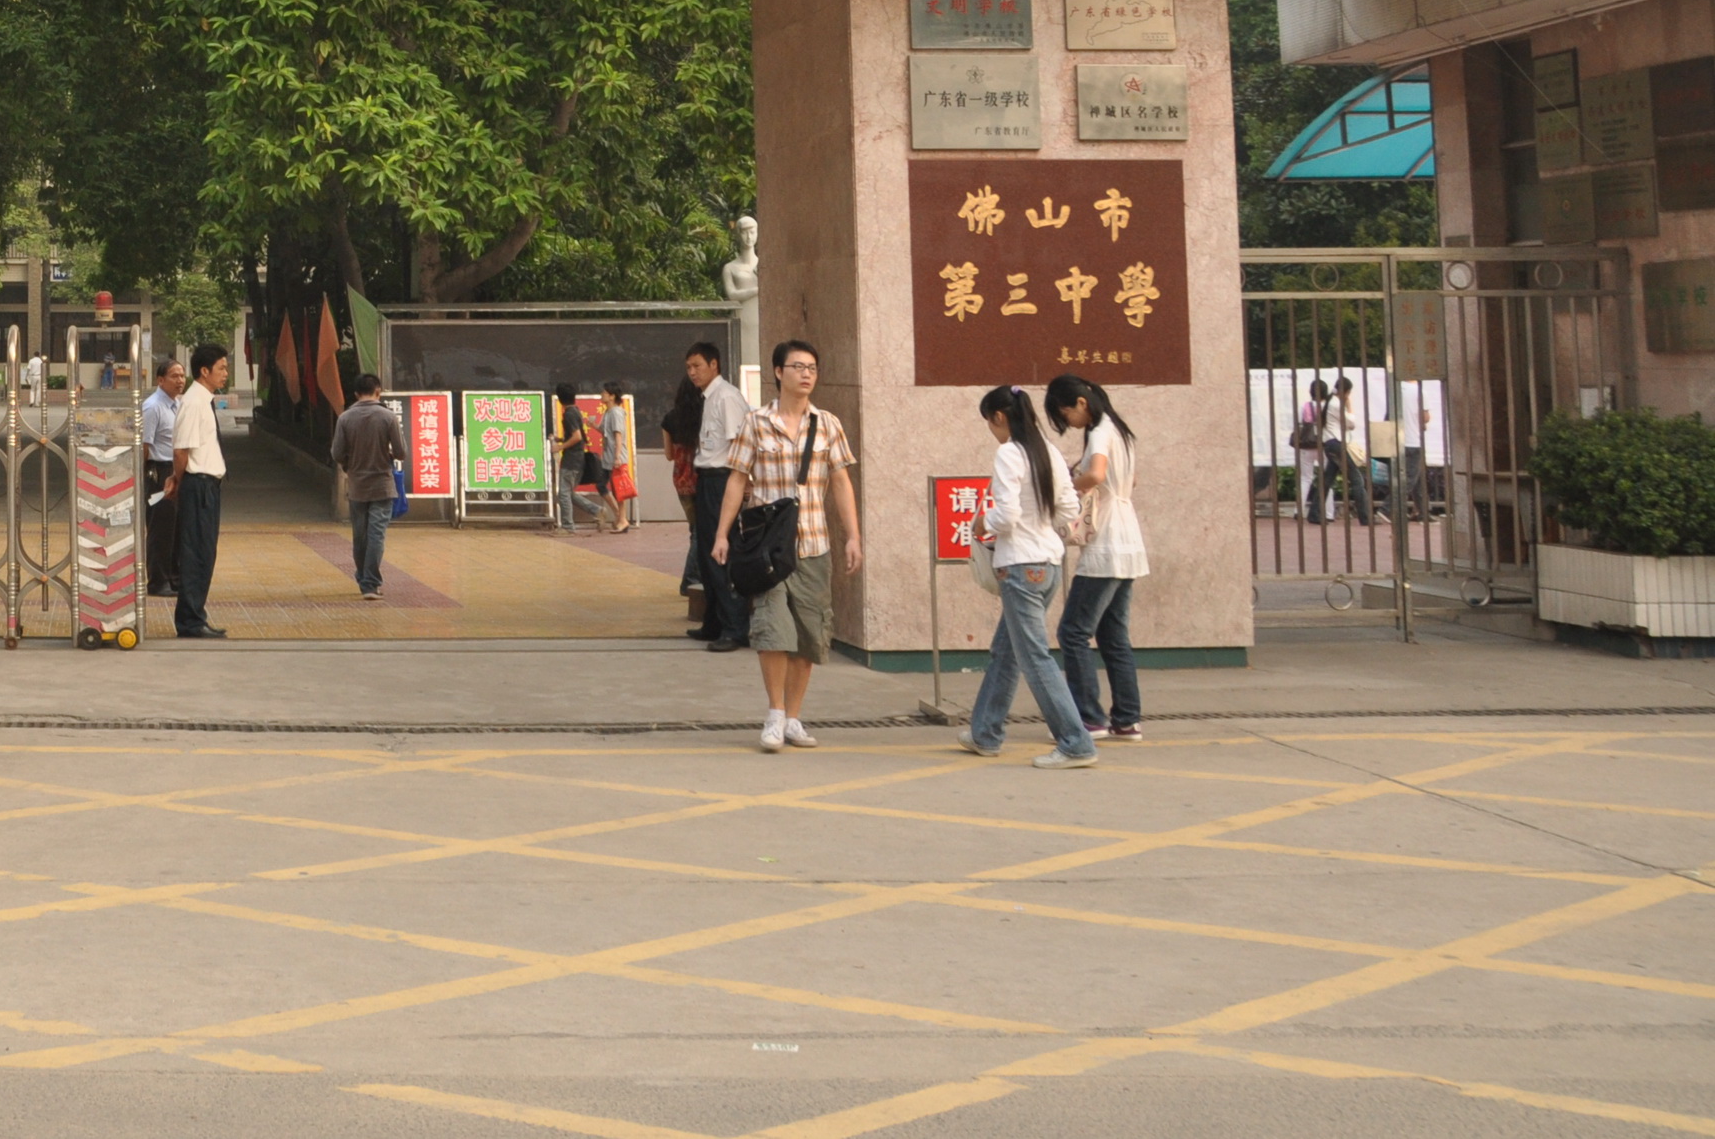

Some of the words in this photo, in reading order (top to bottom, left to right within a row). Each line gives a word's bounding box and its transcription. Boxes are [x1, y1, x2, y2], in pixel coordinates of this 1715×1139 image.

[1069, 6, 1173, 18] 广东省绿色学校
[923, 91, 1030, 108] 广东省一级学校
[1090, 105, 1178, 118] 禅城区名学校
[975, 126, 1029, 136] 广东省教育厅
[958, 184, 1133, 242] 佛山市
[473, 397, 531, 422] 欢迎您
[418, 399, 440, 488] 诚信考试光荣
[482, 427, 525, 452] 参加
[475, 456, 536, 483] 自学考试
